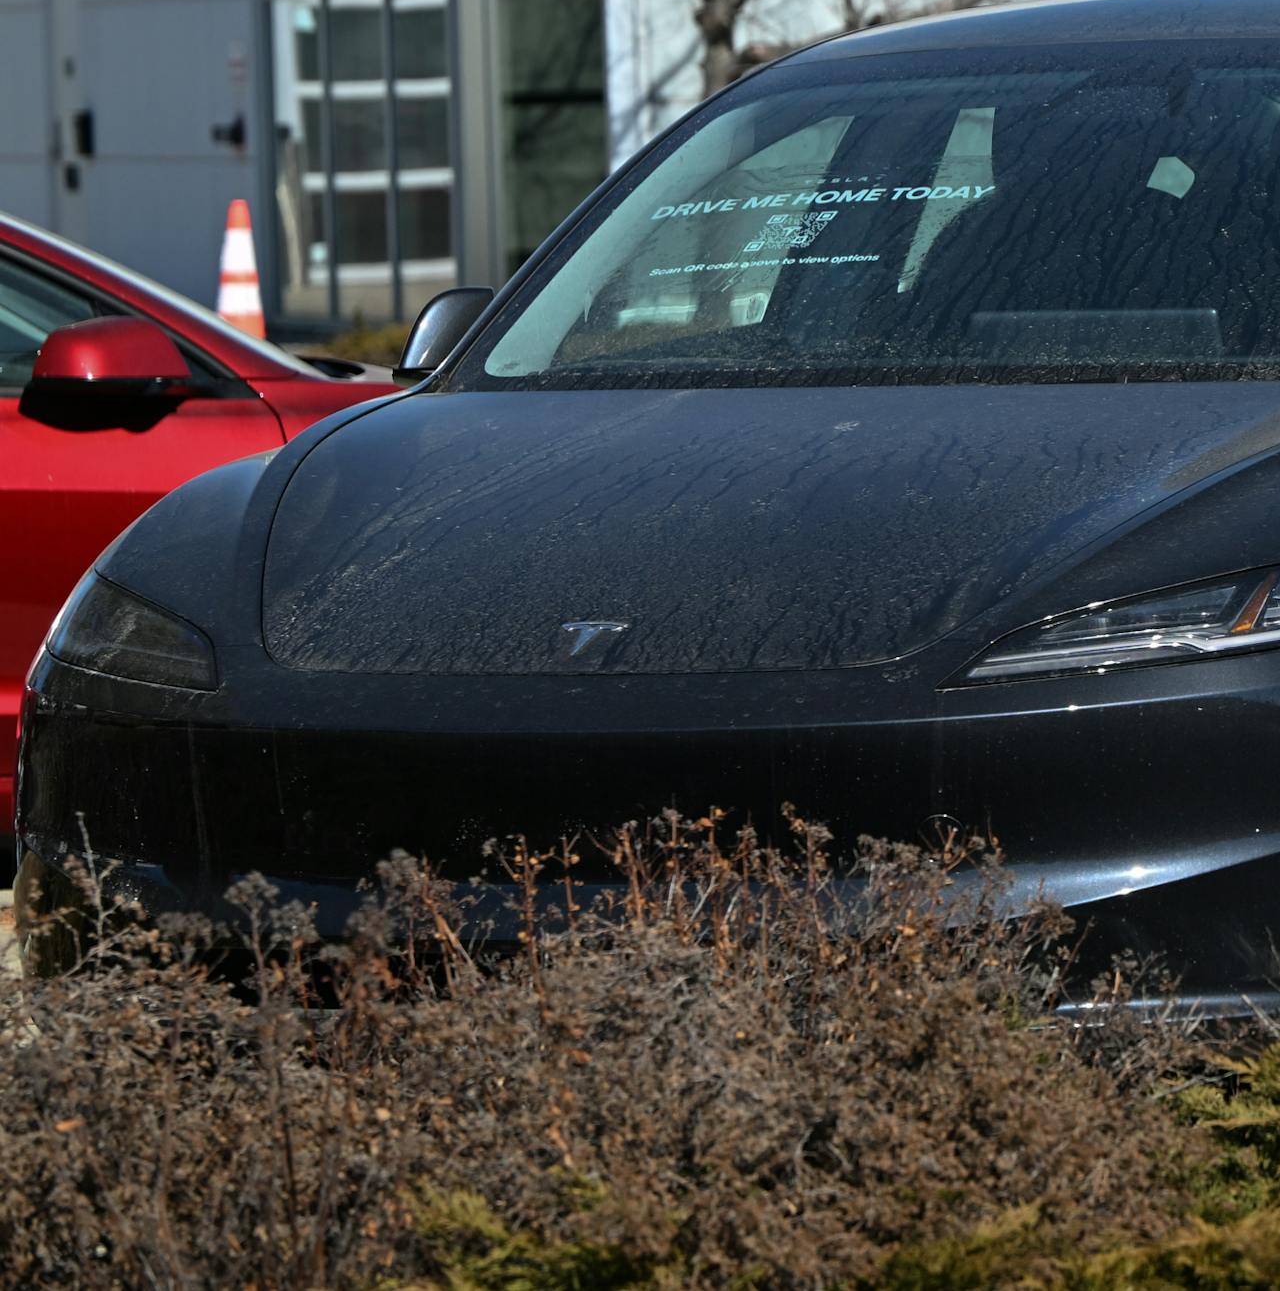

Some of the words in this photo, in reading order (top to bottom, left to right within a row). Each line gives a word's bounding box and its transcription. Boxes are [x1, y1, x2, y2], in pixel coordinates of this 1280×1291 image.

[651, 198, 743, 220] DRIVE
[742, 193, 792, 210] ME
[791, 188, 887, 206] HOME
[891, 185, 996, 201] TODAY
[649, 267, 682, 277] Scan
[683, 263, 706, 273] QR
[782, 257, 796, 265] to
[799, 255, 830, 264] view
[830, 253, 881, 265] options
